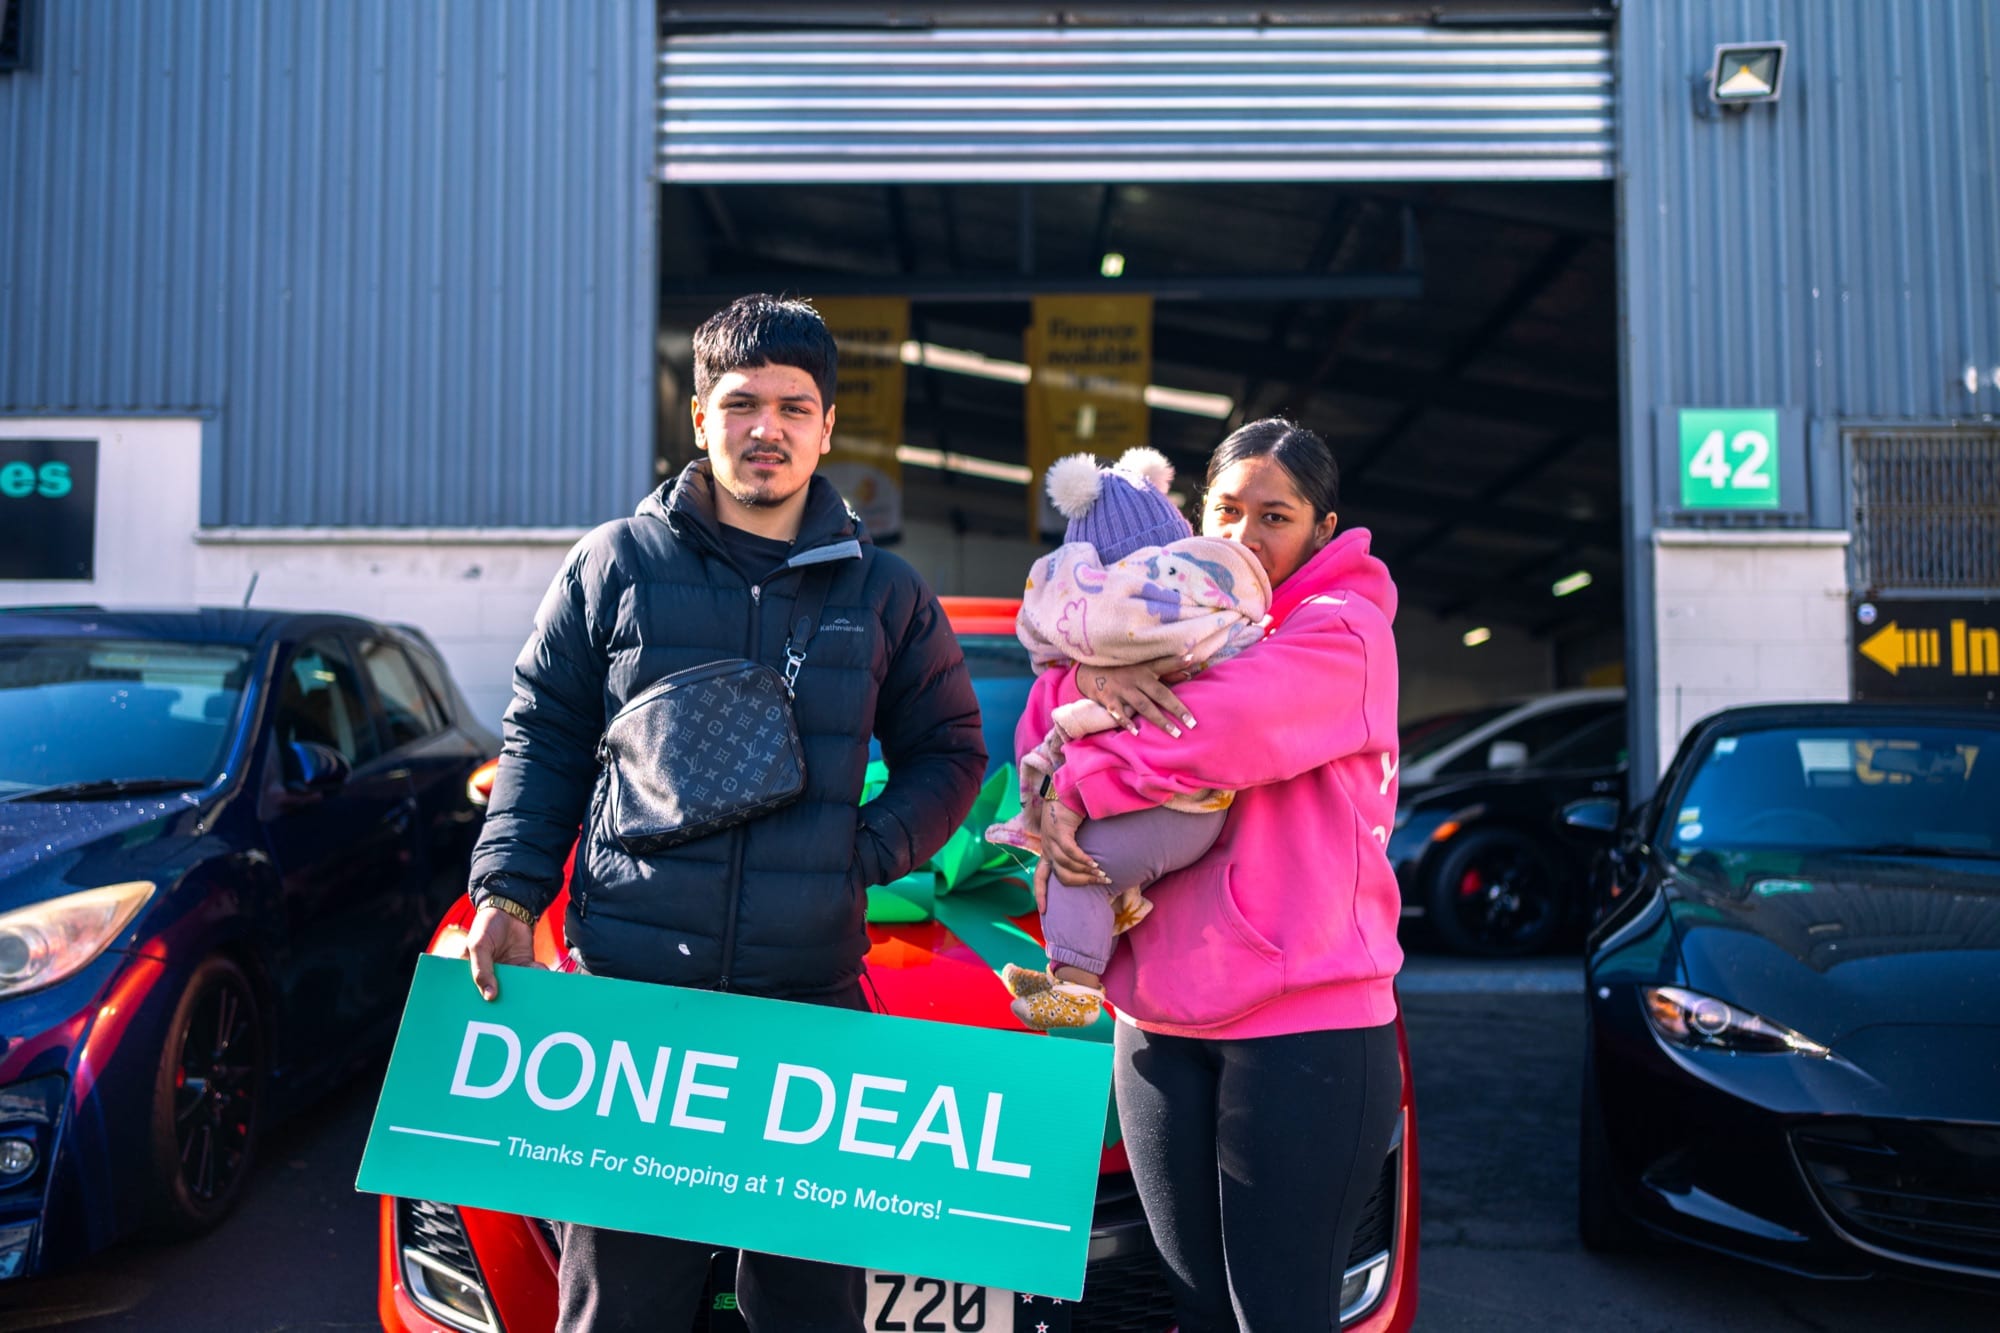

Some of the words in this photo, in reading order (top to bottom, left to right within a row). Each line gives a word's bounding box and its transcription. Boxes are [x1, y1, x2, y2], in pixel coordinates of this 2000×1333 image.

[1689, 429, 1770, 489] 42
[450, 1020, 739, 1134] DONE
[763, 1062, 1032, 1178] DEAL
[507, 1136, 584, 1166] Thanks
[590, 1148, 628, 1172] For
[632, 1155, 739, 1194] Shopping
[744, 1174, 768, 1194] at
[775, 1176, 785, 1196] 1
[793, 1179, 847, 1209] Stop
[853, 1187, 943, 1220] Motors!
[874, 1274, 986, 1332] Z20
